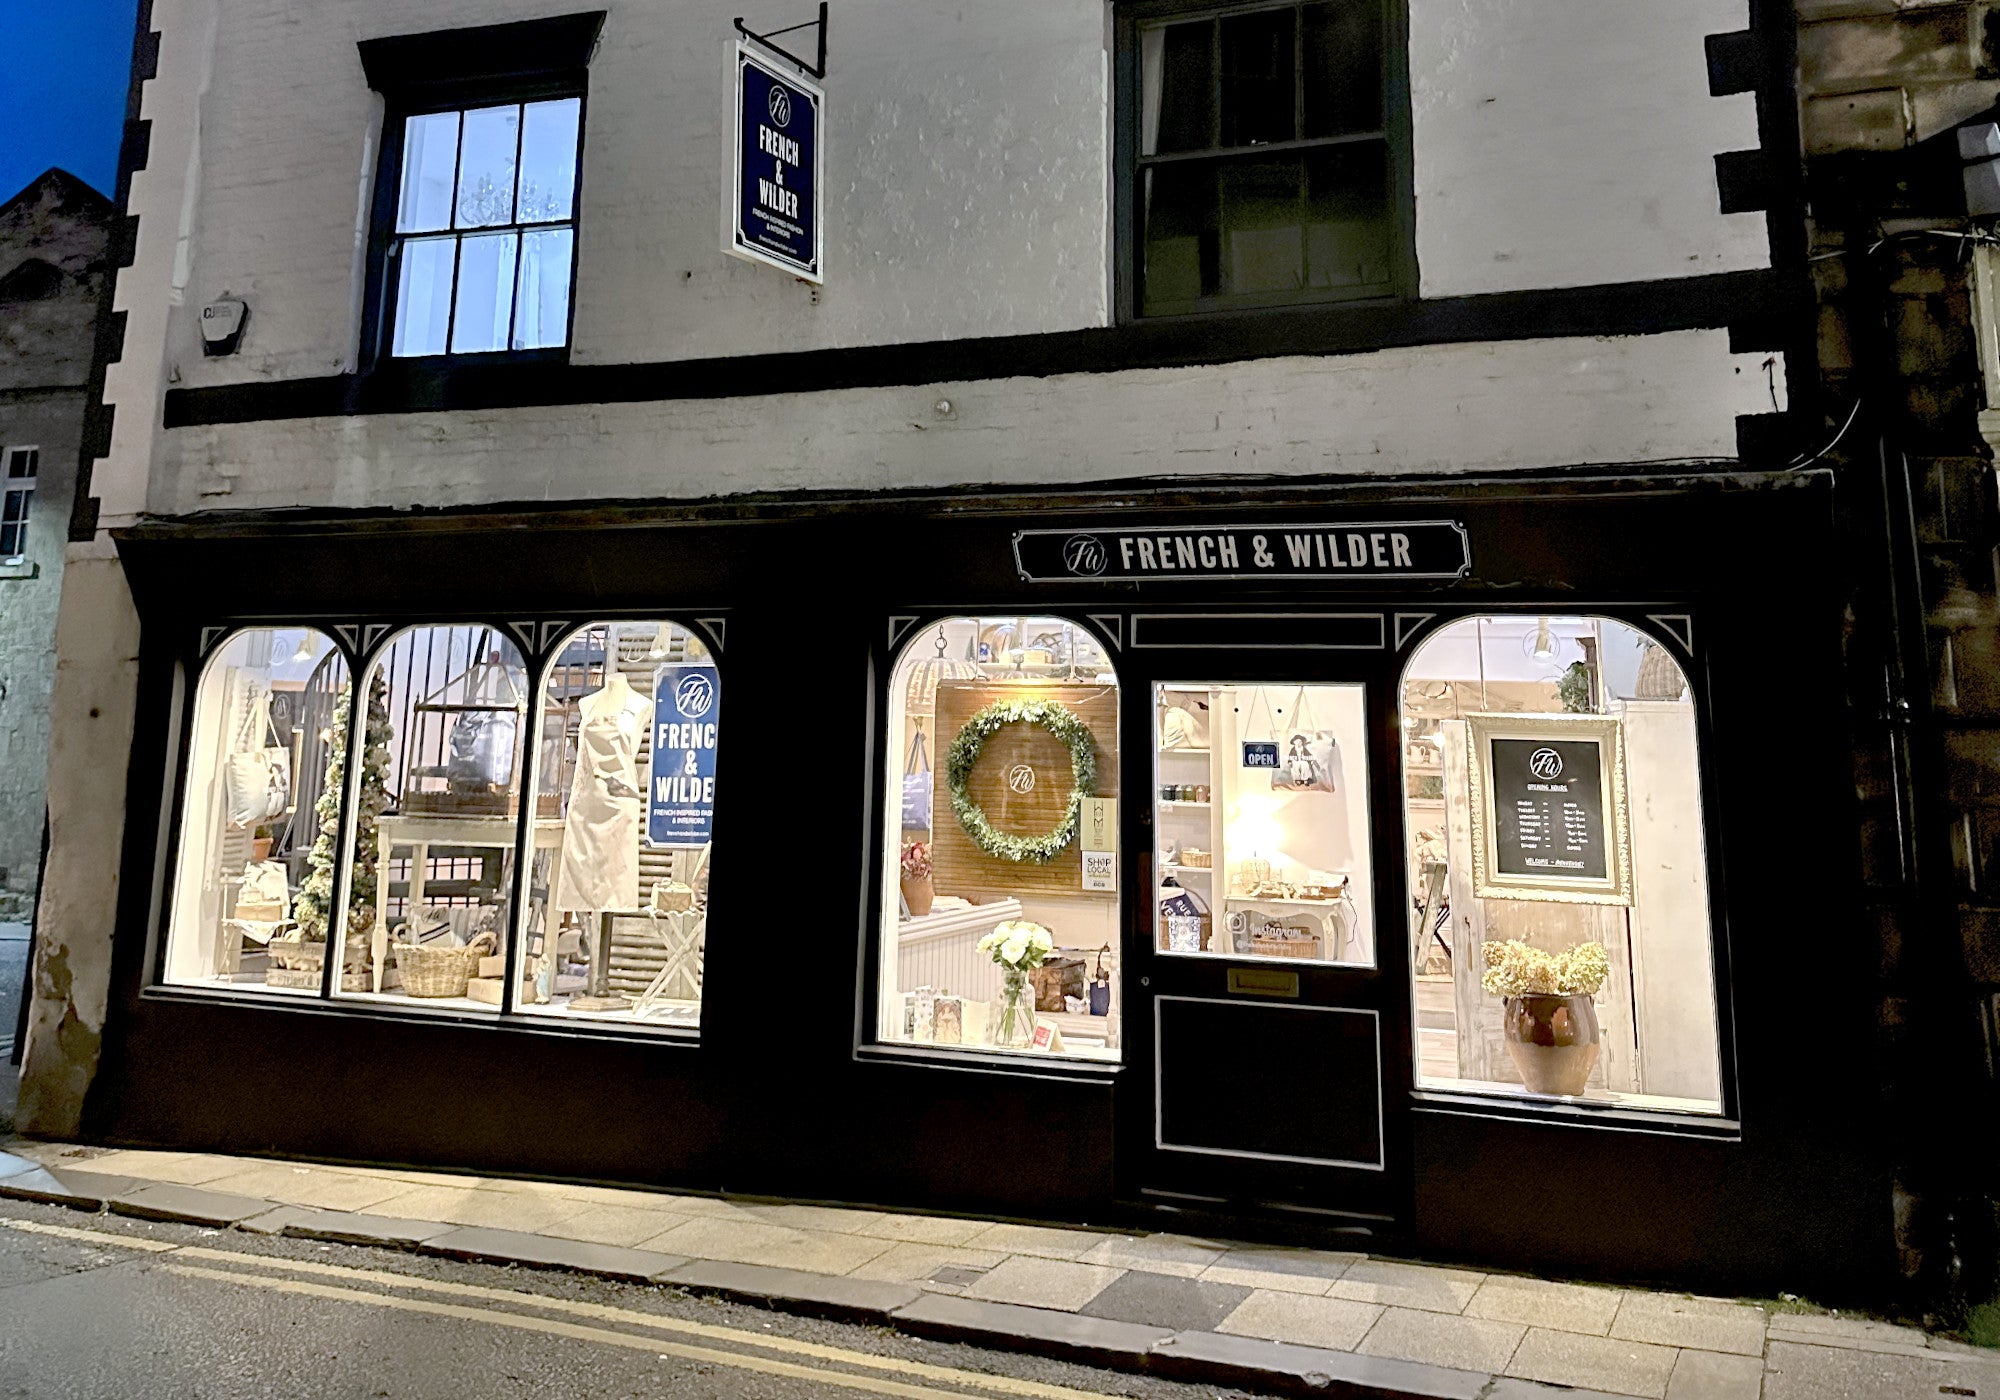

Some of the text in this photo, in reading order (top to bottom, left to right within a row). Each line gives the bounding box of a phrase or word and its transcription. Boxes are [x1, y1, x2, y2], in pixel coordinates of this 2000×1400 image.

[759, 124, 799, 168] FRENCH
[776, 159, 784, 186] &
[759, 178, 798, 219] WILDER
[1119, 535, 1240, 570] FRENCH
[1252, 534, 1275, 568] &
[1284, 533, 1413, 568] WILDER
[657, 723, 716, 749] FRENC
[684, 750, 698, 775] &
[1247, 753, 1275, 766] OPEN
[655, 776, 713, 803] WILDE
[1087, 857, 1112, 867] SHOP
[1087, 866, 1112, 874] LOCAL
[1175, 900, 1192, 917] RUE
[1249, 923, 1303, 942] Instagram
